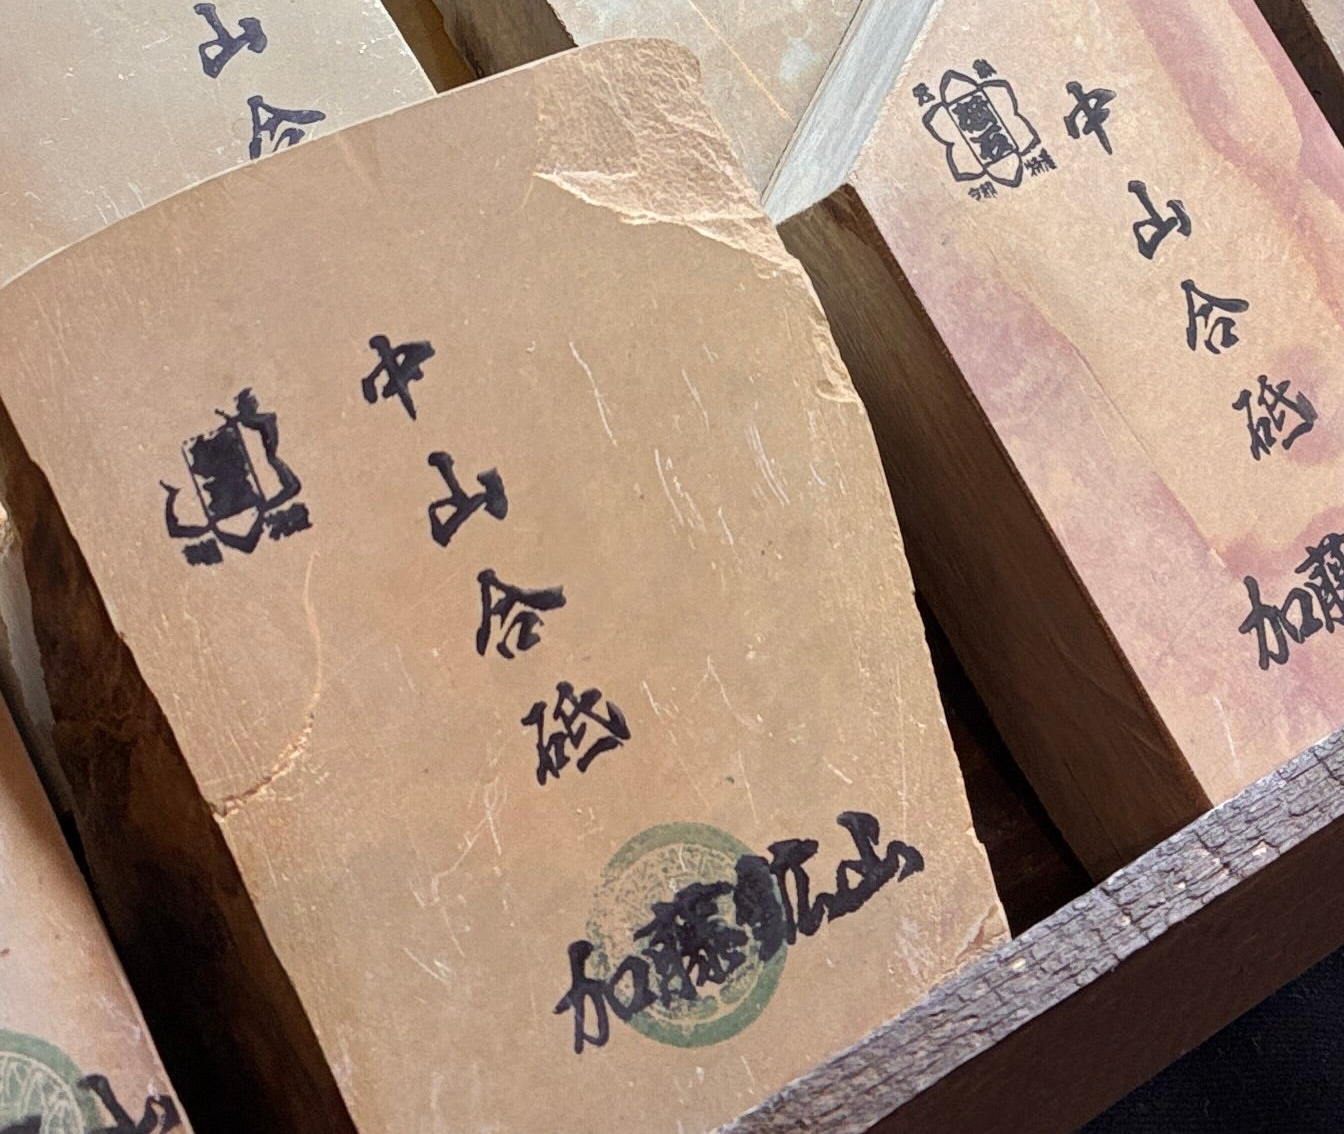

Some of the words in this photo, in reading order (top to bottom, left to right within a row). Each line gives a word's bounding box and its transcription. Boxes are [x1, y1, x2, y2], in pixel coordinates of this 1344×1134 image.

[1063, 80, 1318, 460] 中山合砥
[361, 334, 631, 786] 中山合砥
